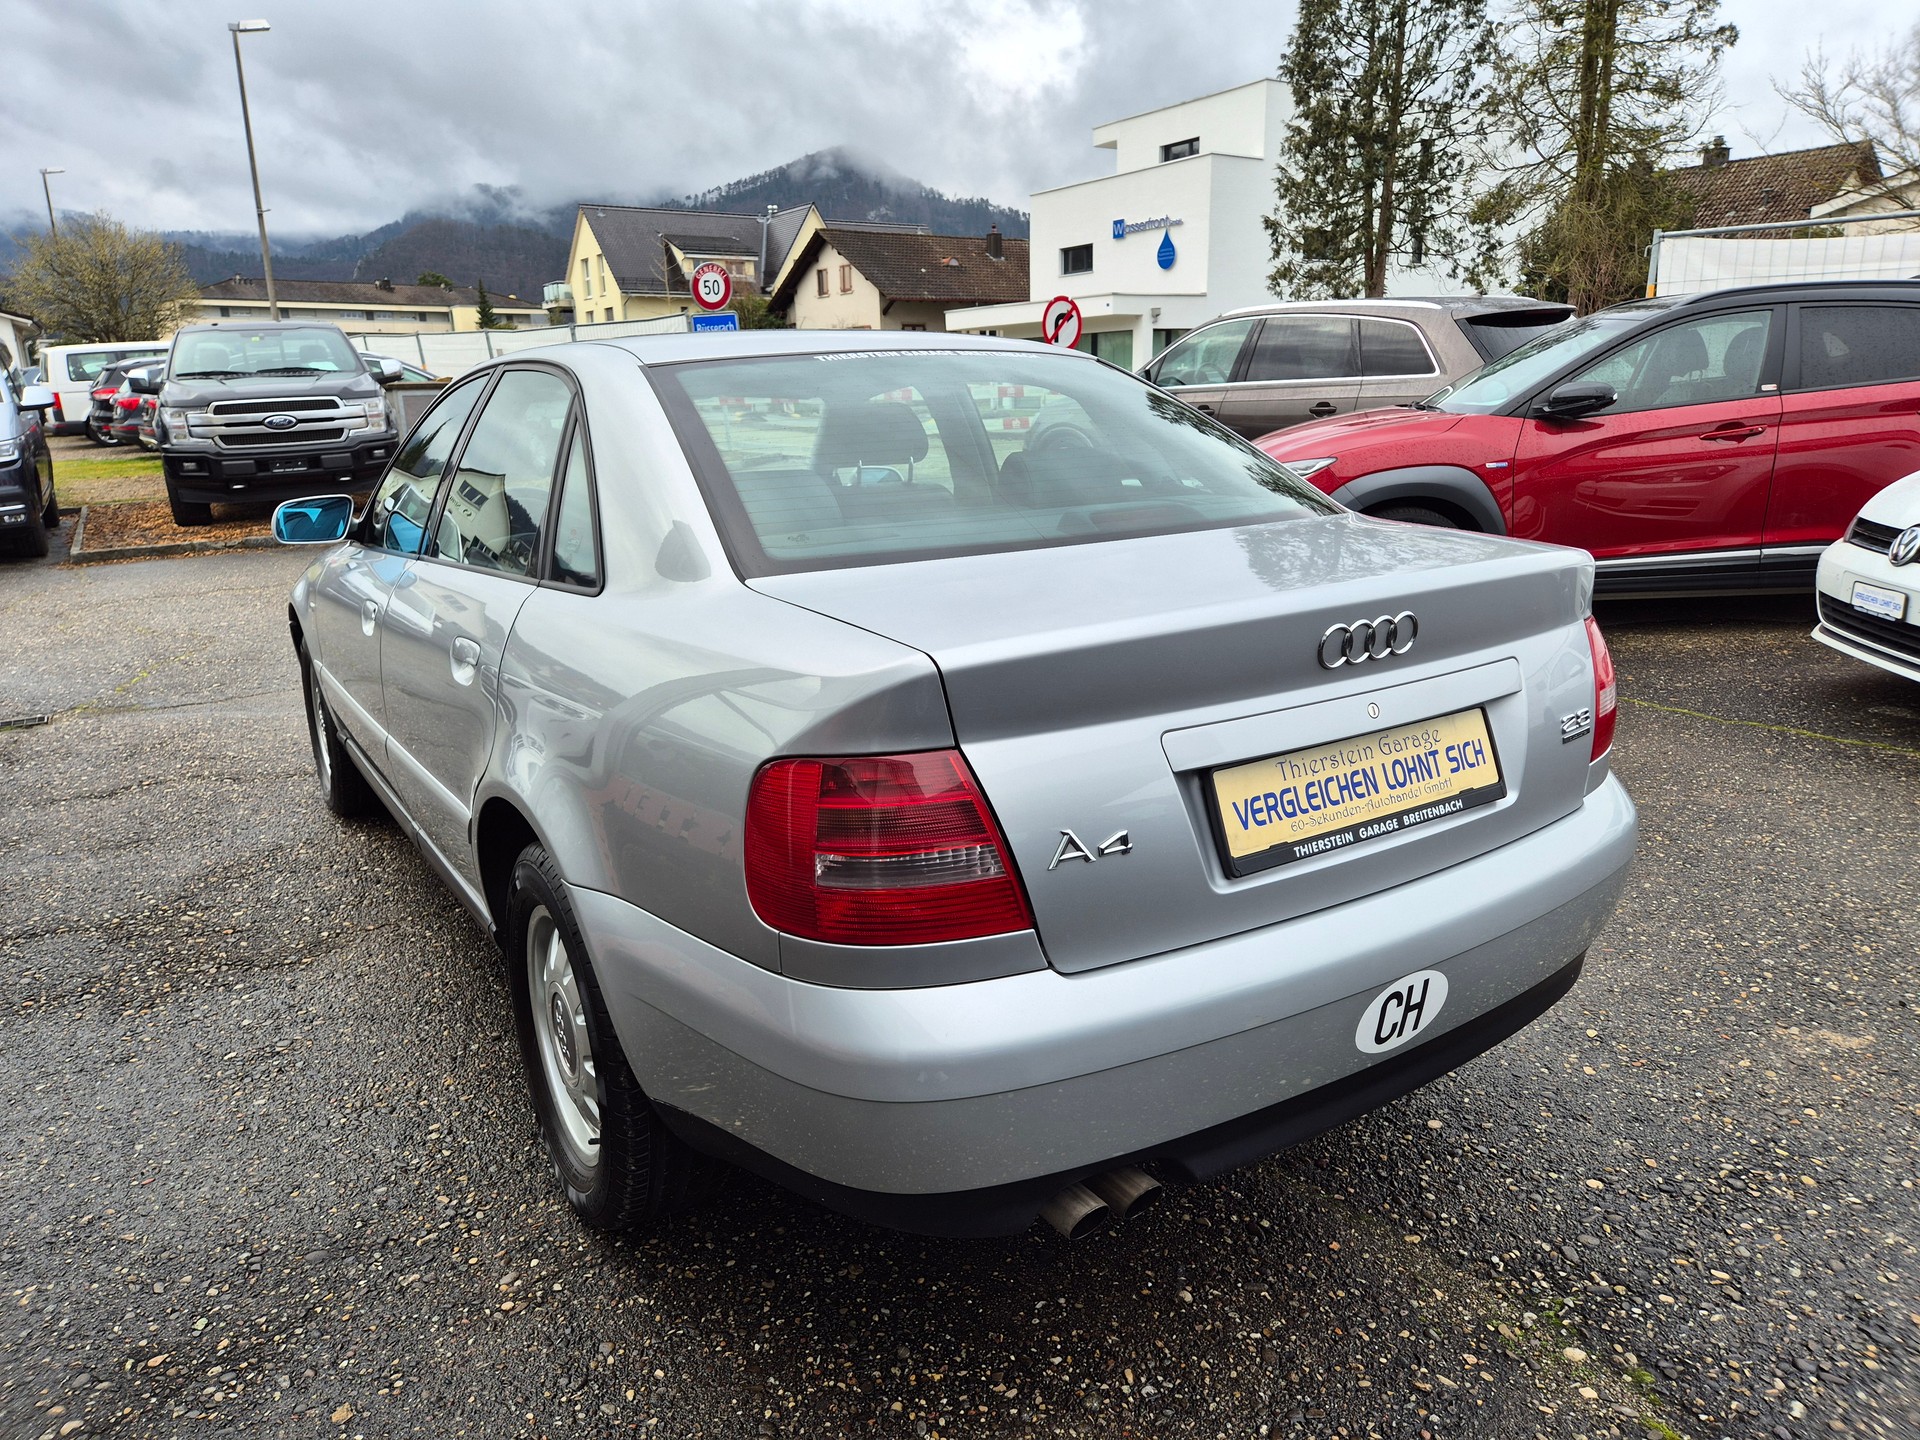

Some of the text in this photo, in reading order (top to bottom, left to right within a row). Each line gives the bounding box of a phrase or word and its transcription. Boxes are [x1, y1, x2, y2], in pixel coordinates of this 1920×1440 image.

[695, 264, 728, 279] GENERELL
[703, 279, 720, 295] 50
[813, 351, 901, 362] THIERSTEIN
[1275, 729, 1442, 781] Thierstein Garage
[1232, 738, 1487, 831] VERGLEICHEN LOHNT SICH
[1290, 777, 1453, 832] 60-Sekunden-Autohandel GmbH
[1047, 829, 1133, 871] A4
[1293, 799, 1464, 858] THIERSTEIN GARAGE BREITENBACH
[1374, 977, 1430, 1046] CH
